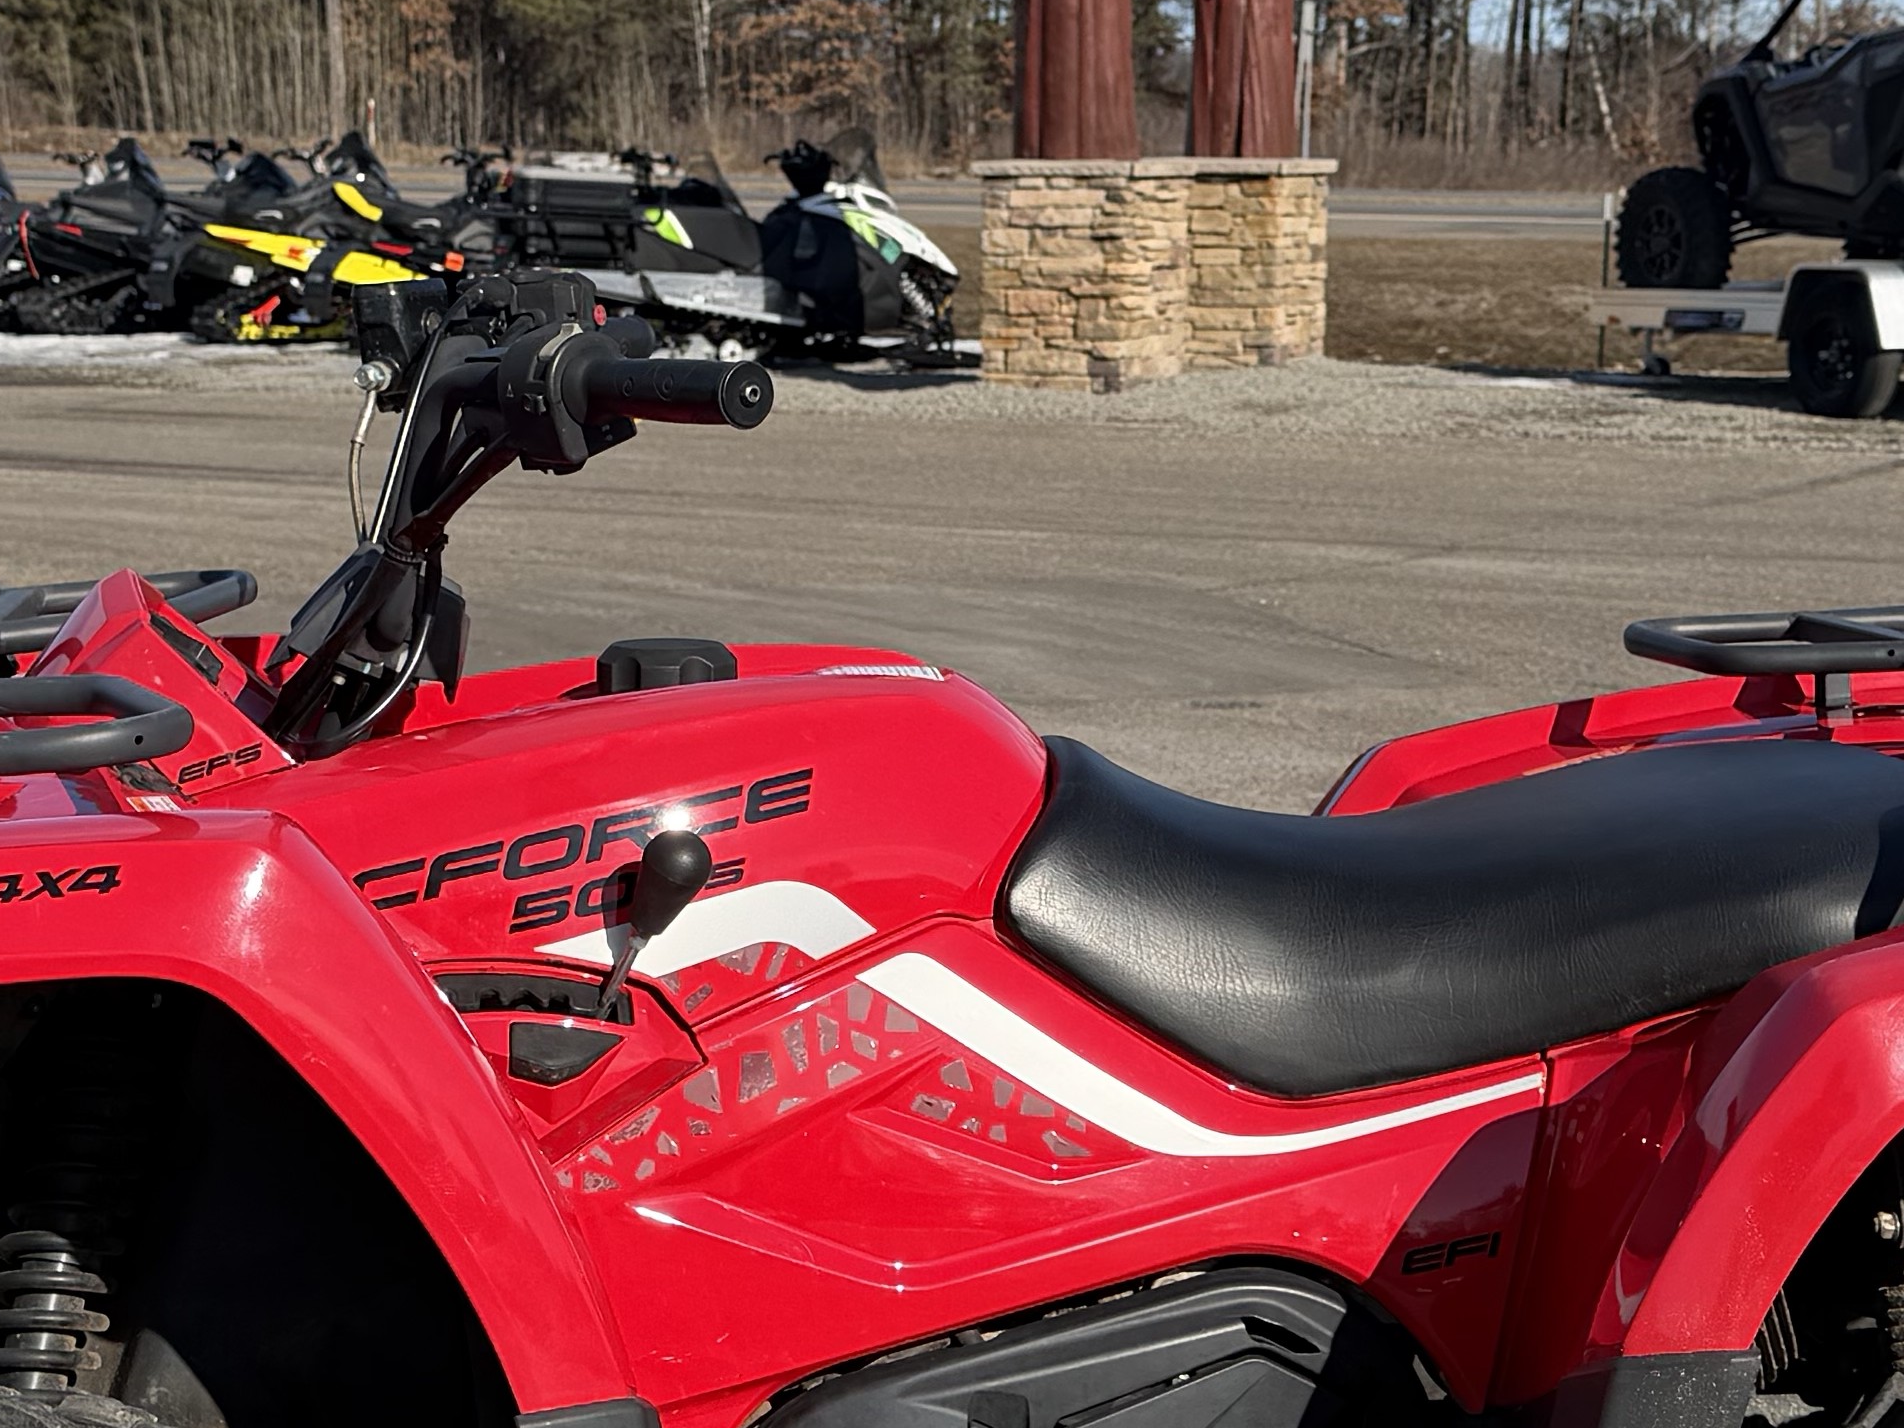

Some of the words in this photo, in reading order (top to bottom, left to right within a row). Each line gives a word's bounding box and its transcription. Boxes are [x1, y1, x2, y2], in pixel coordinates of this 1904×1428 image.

[177, 742, 263, 784] EPS
[509, 858, 746, 934] 50S
[1401, 1231, 1501, 1275] EFI
